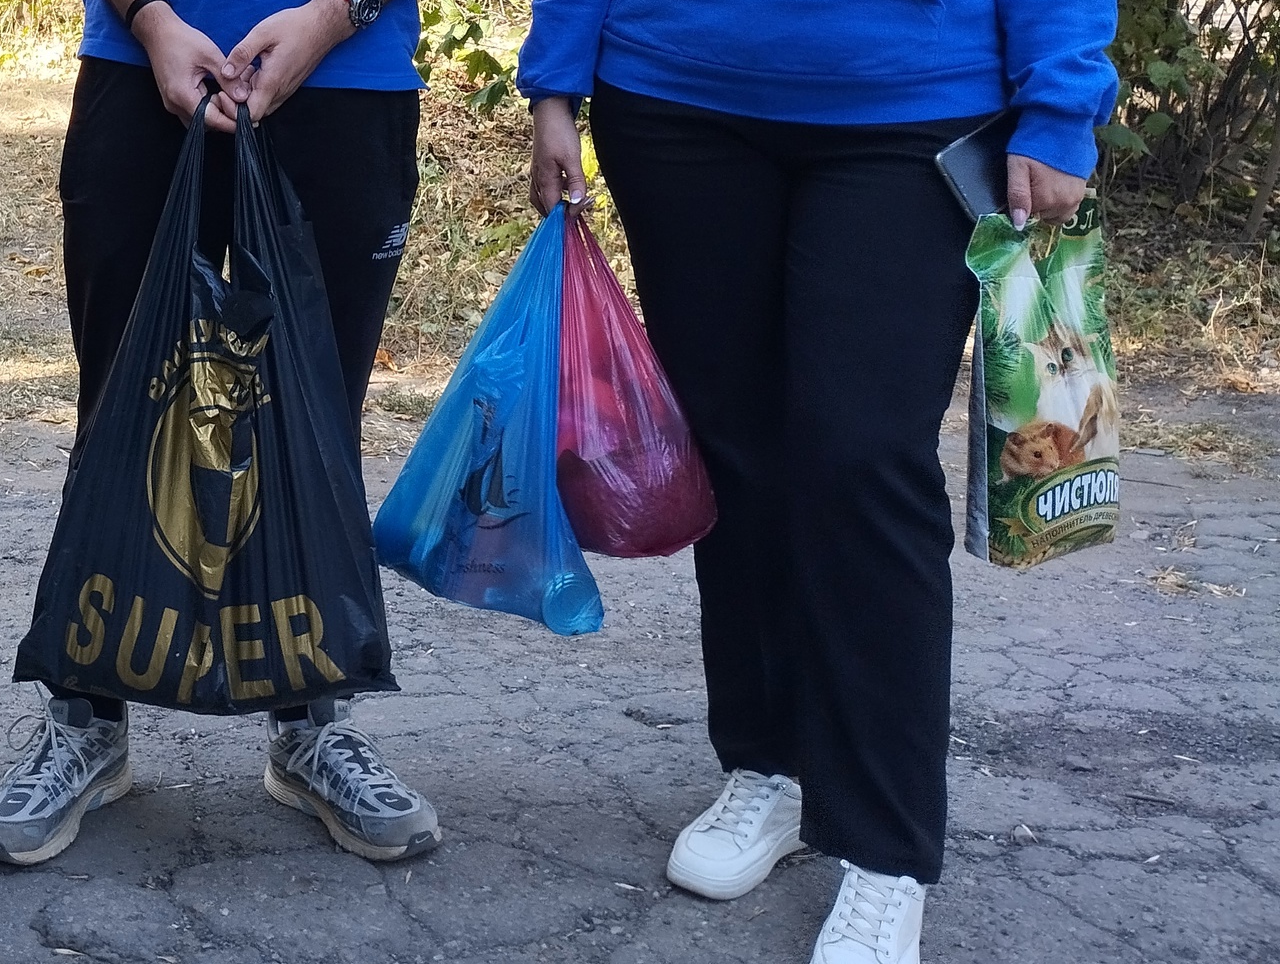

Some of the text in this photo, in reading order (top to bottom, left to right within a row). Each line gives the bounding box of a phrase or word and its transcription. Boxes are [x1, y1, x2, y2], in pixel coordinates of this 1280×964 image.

[372, 252, 388, 260] new
[1031, 514, 1093, 548] НАПОЛНИТЕЛЬ
[65, 573, 347, 704] SUPER
